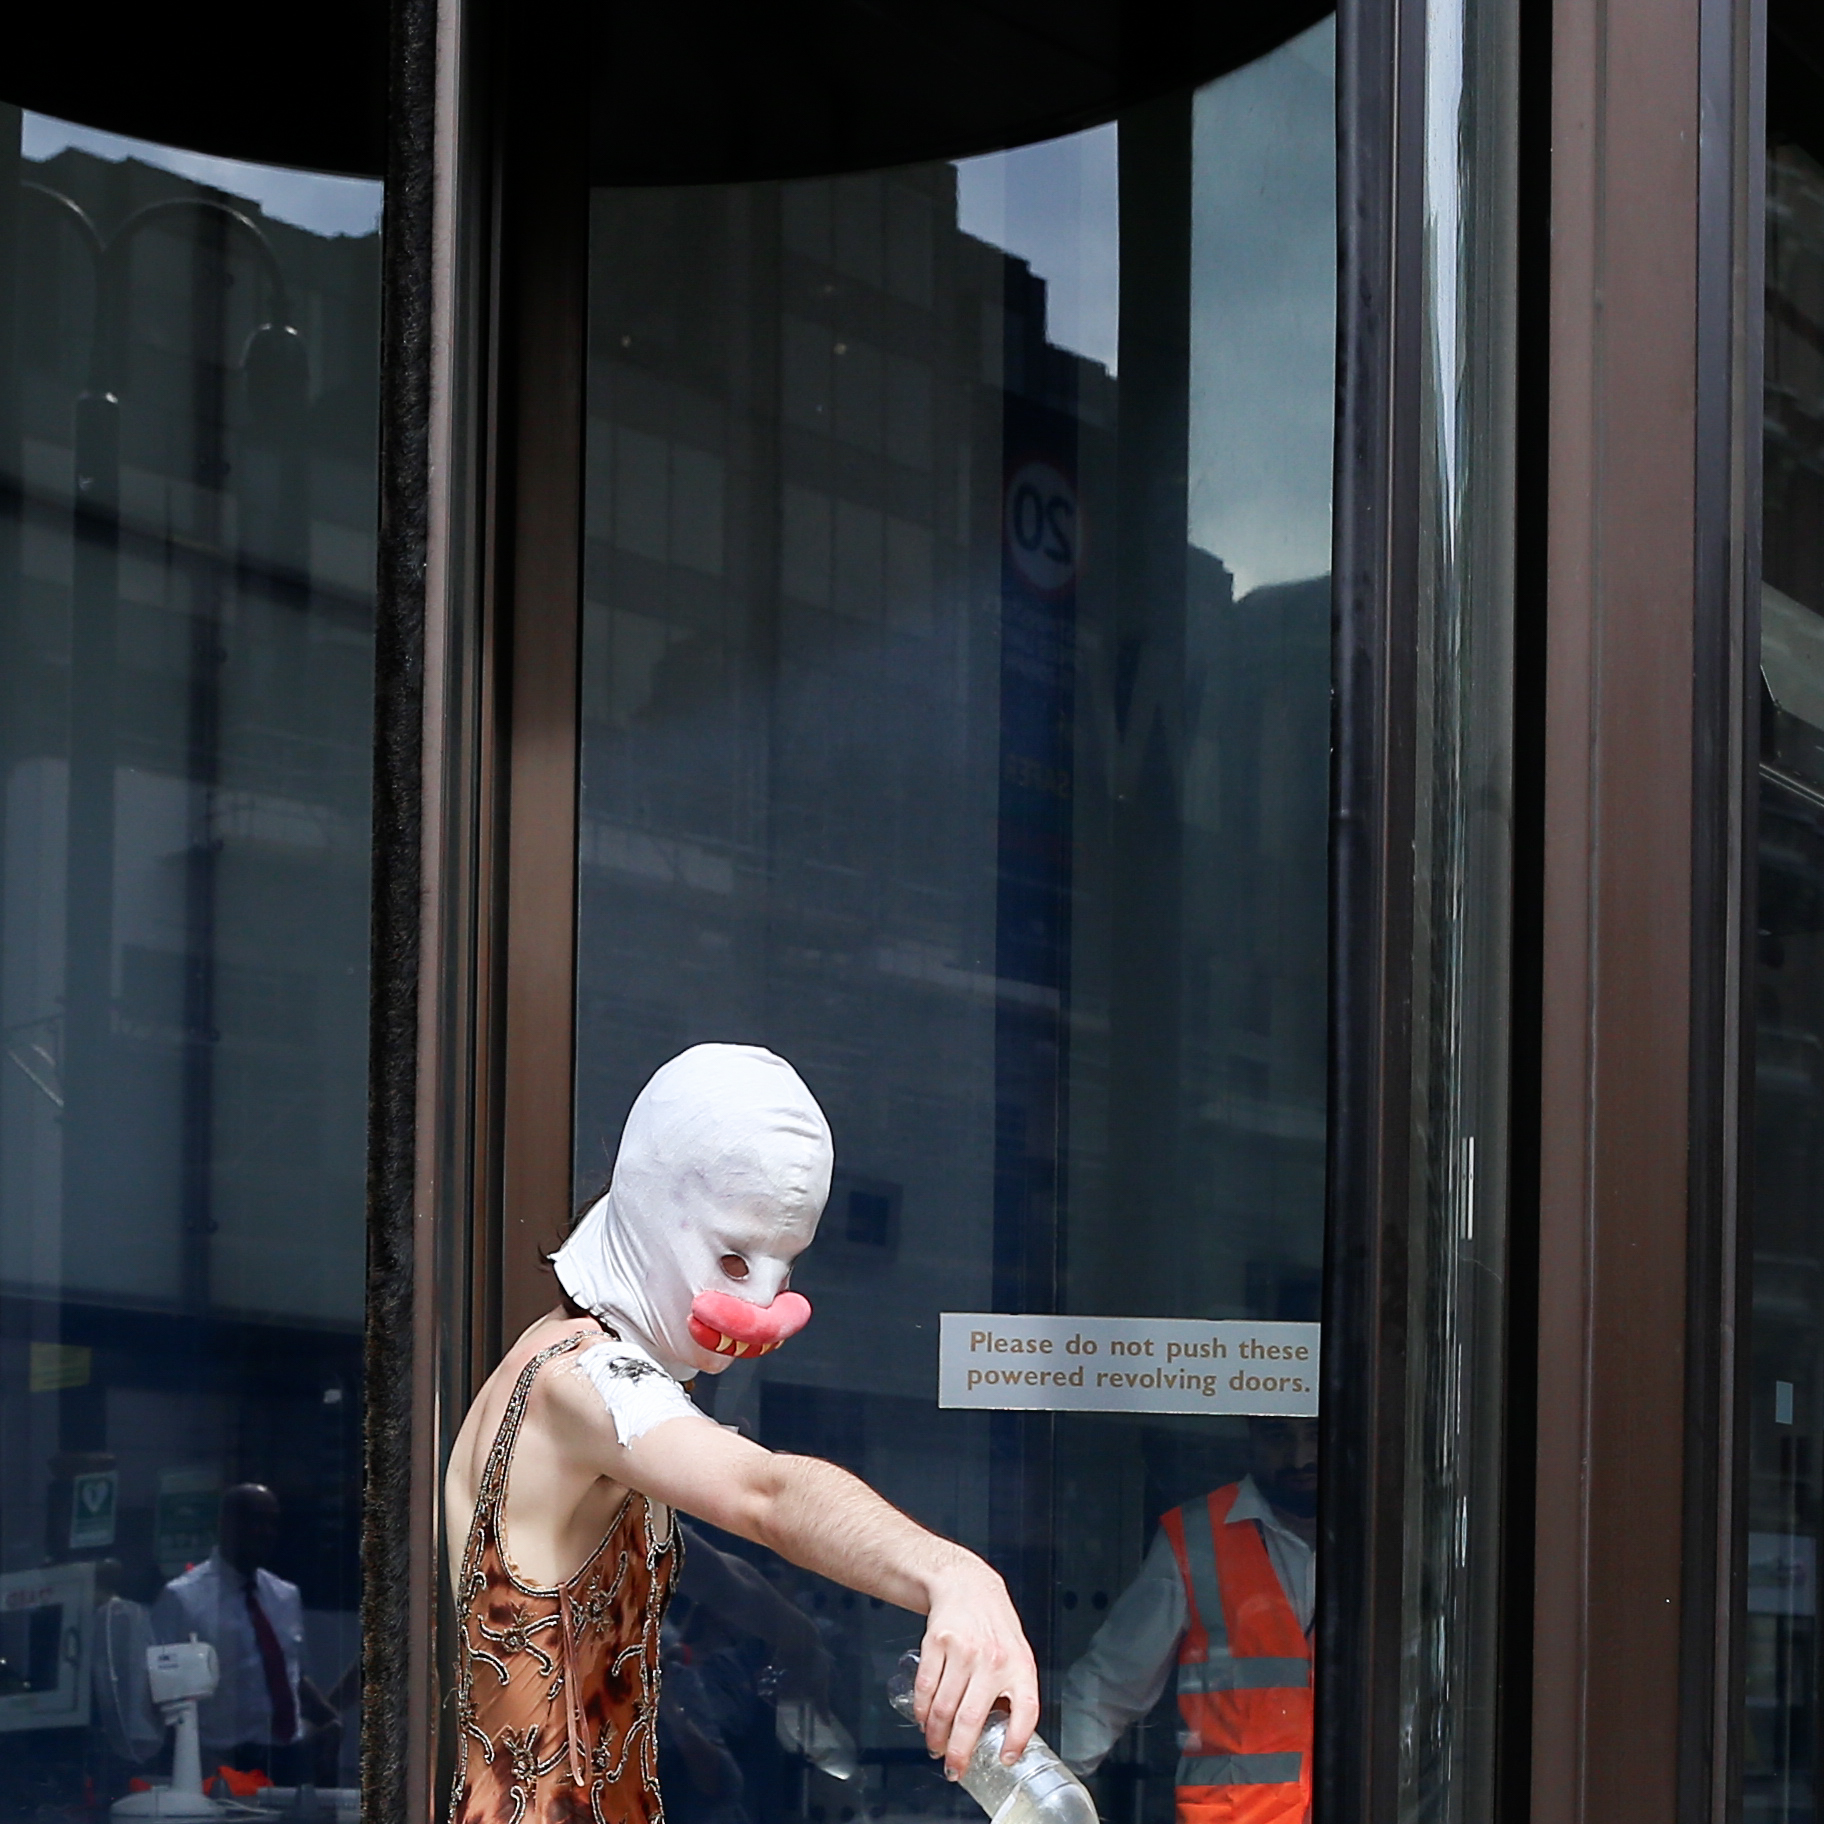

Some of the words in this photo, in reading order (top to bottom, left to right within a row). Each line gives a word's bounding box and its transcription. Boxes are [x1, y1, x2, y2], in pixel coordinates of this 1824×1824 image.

[970, 1331, 1053, 1354] Please
[1065, 1333, 1097, 1355] do
[1110, 1337, 1155, 1357] not
[1166, 1337, 1227, 1364] push
[1239, 1338, 1309, 1361] these
[967, 1365, 1084, 1391] powered
[1096, 1367, 1217, 1397] revolving
[1229, 1370, 1310, 1393] doors.
